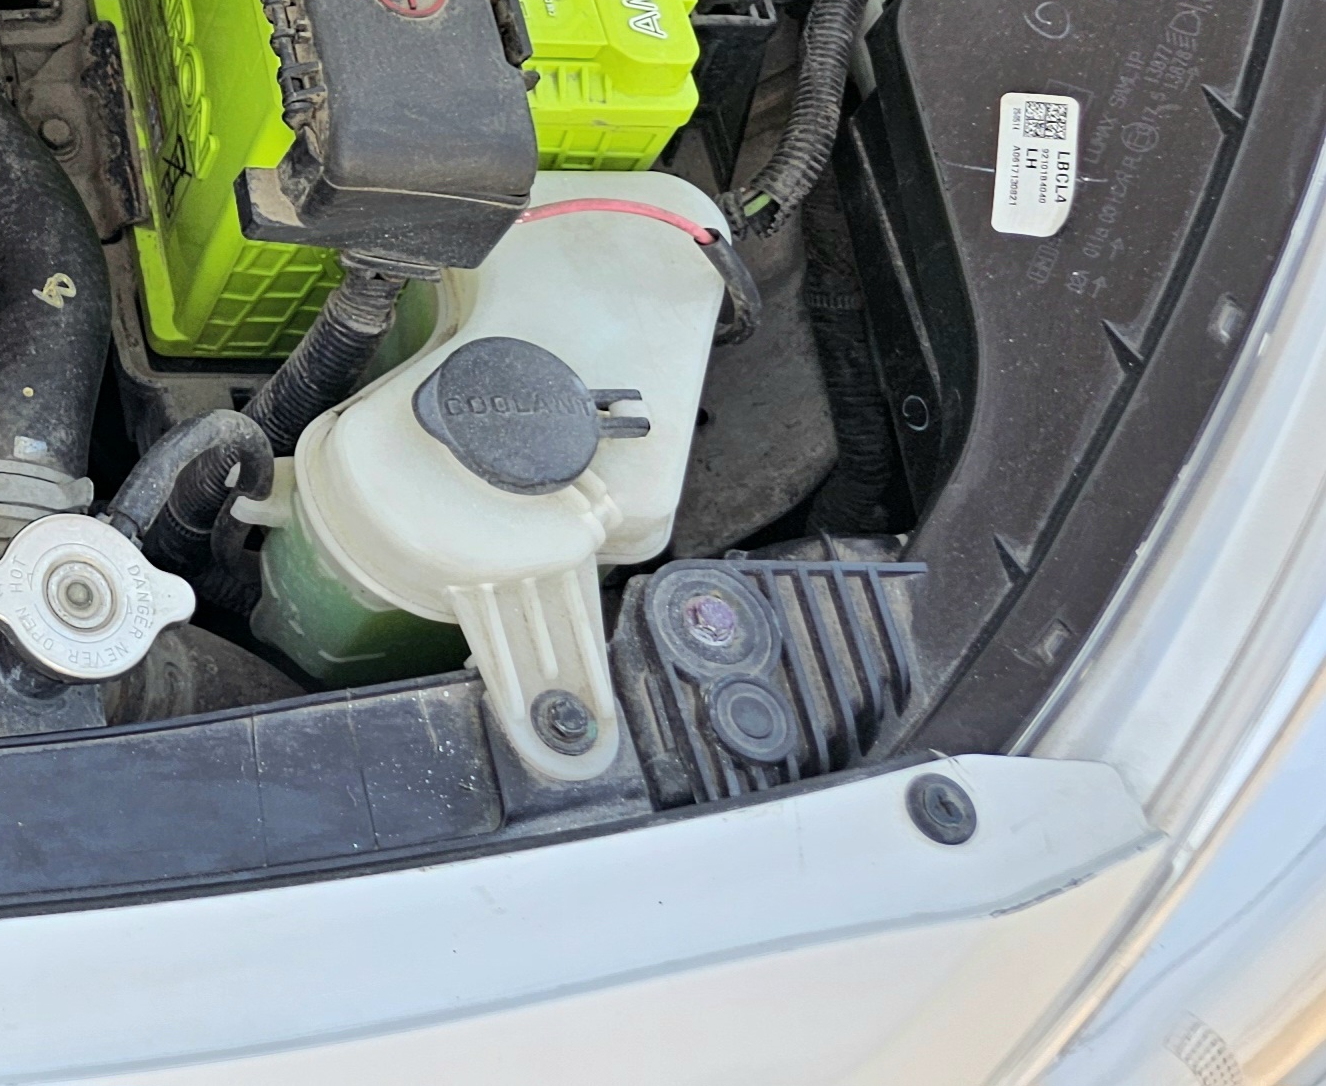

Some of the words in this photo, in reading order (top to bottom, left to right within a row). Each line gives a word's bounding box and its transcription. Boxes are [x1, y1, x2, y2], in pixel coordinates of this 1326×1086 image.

[1025, 148, 1039, 169] LH
[1054, 151, 1071, 203] LBCL4
[444, 397, 593, 418] COOLANT
[10, 556, 27, 593] HOT
[127, 563, 151, 640] DANGER
[15, 605, 56, 653] OPEN
[68, 641, 130, 669] NEVER
